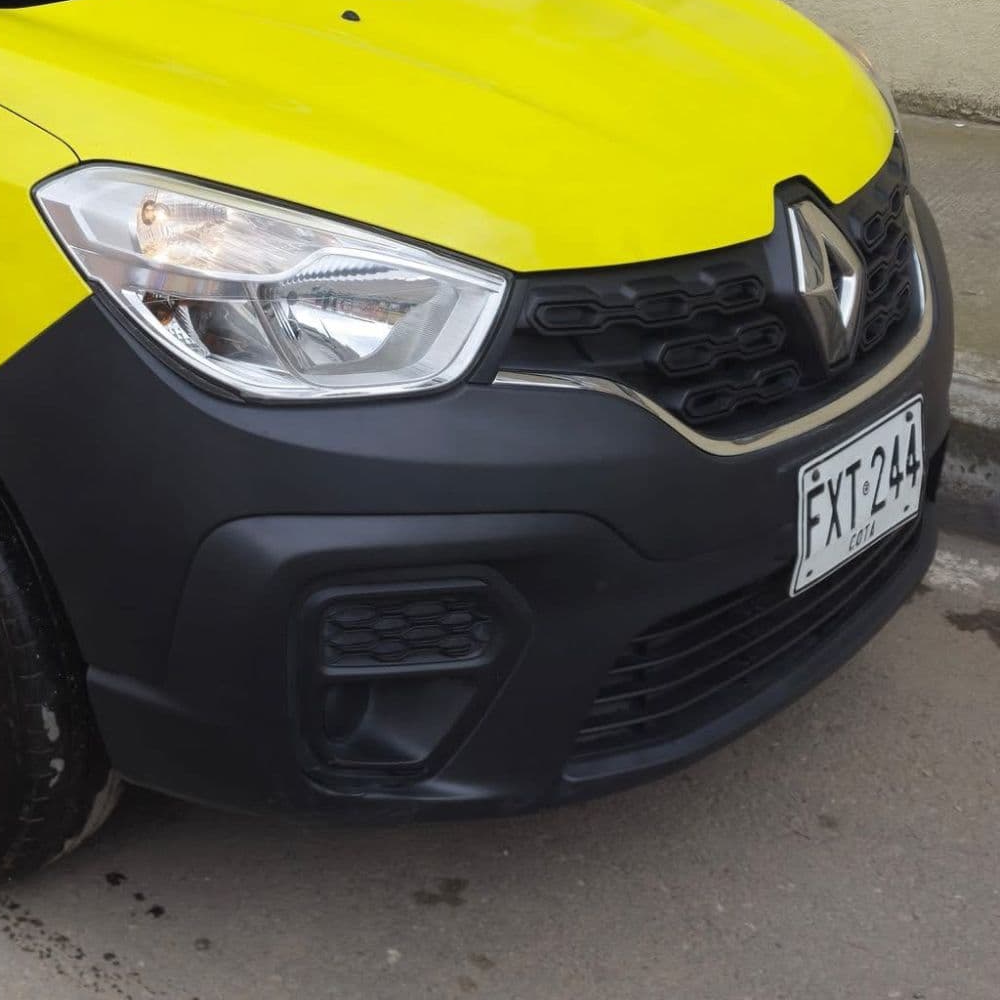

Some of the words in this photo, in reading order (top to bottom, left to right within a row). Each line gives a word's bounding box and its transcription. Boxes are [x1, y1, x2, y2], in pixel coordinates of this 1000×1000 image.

[806, 459, 861, 560] FXT
[870, 423, 921, 516] 244
[849, 520, 876, 551] COTA
